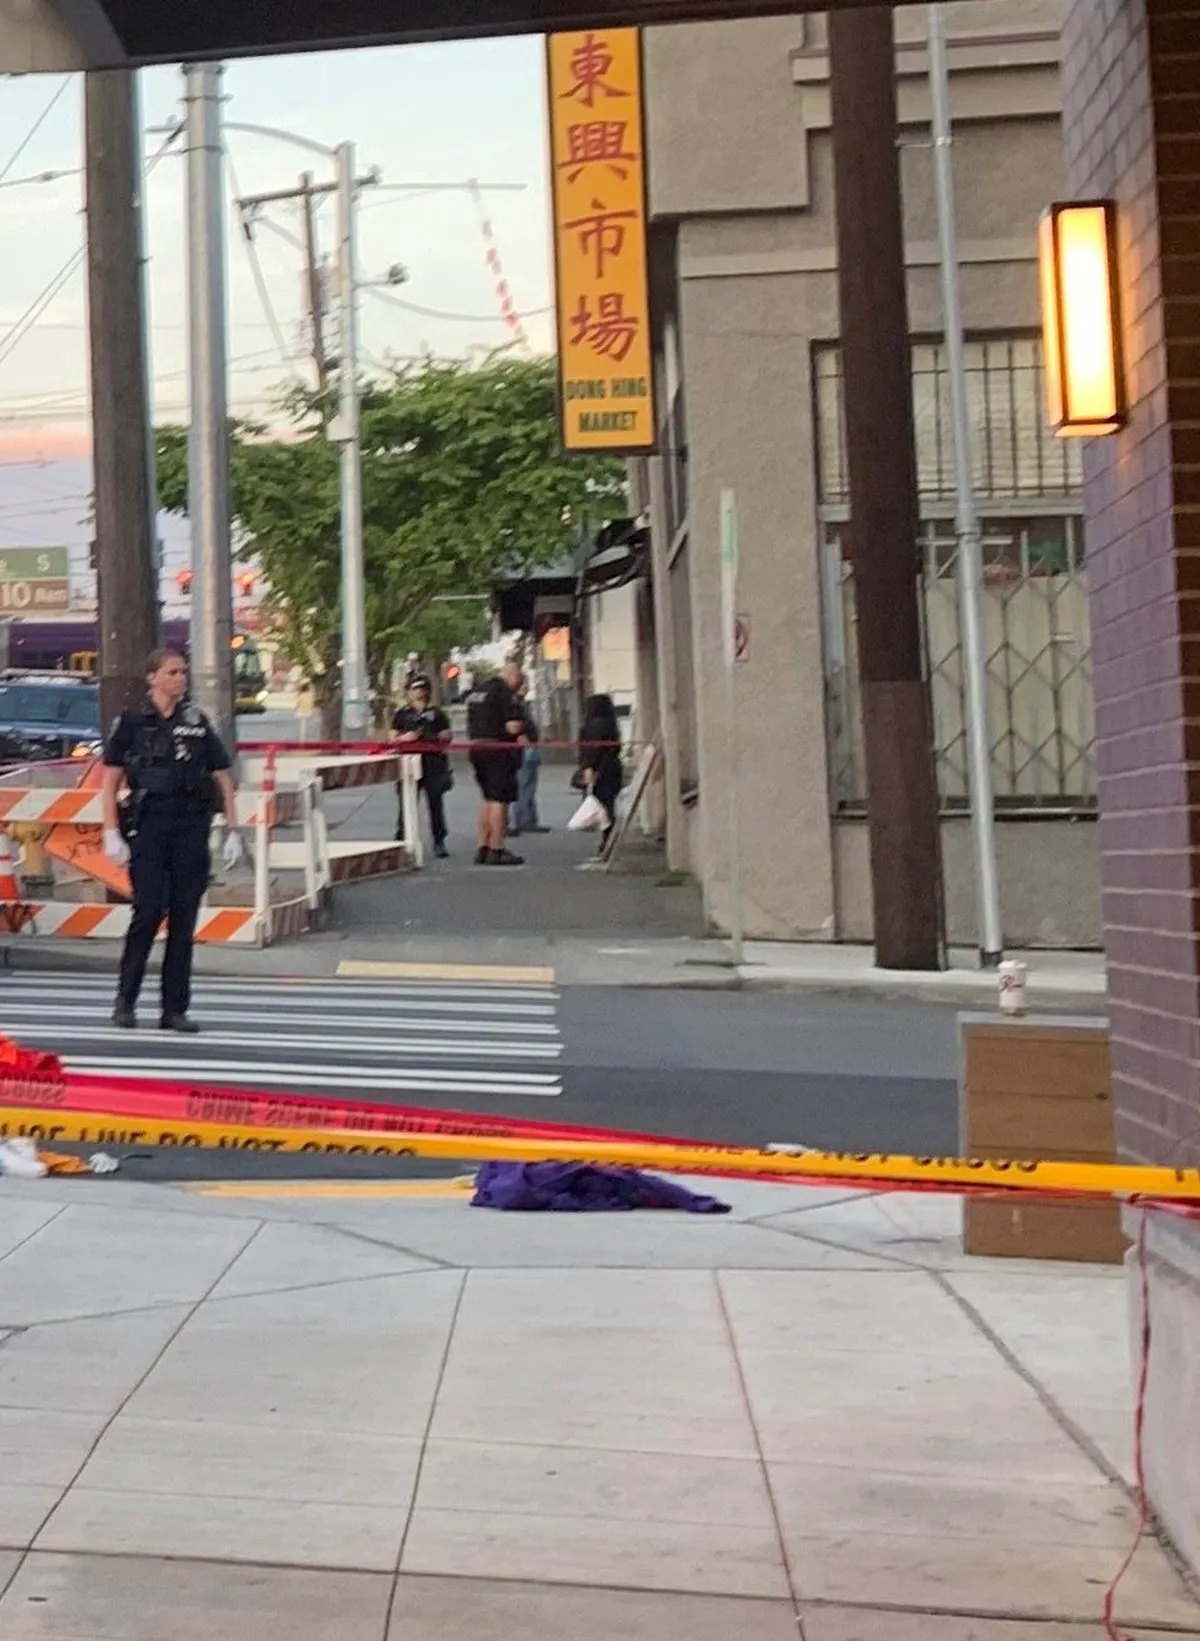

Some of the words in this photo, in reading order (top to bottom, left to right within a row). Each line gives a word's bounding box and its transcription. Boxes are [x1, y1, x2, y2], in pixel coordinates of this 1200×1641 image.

[557, 34, 639, 363] 東興市場
[565, 379, 605, 401] DONG
[611, 376, 647, 398] HING
[578, 411, 639, 432] MARKET
[36, 553, 50, 572] S
[1, 581, 31, 608] 10
